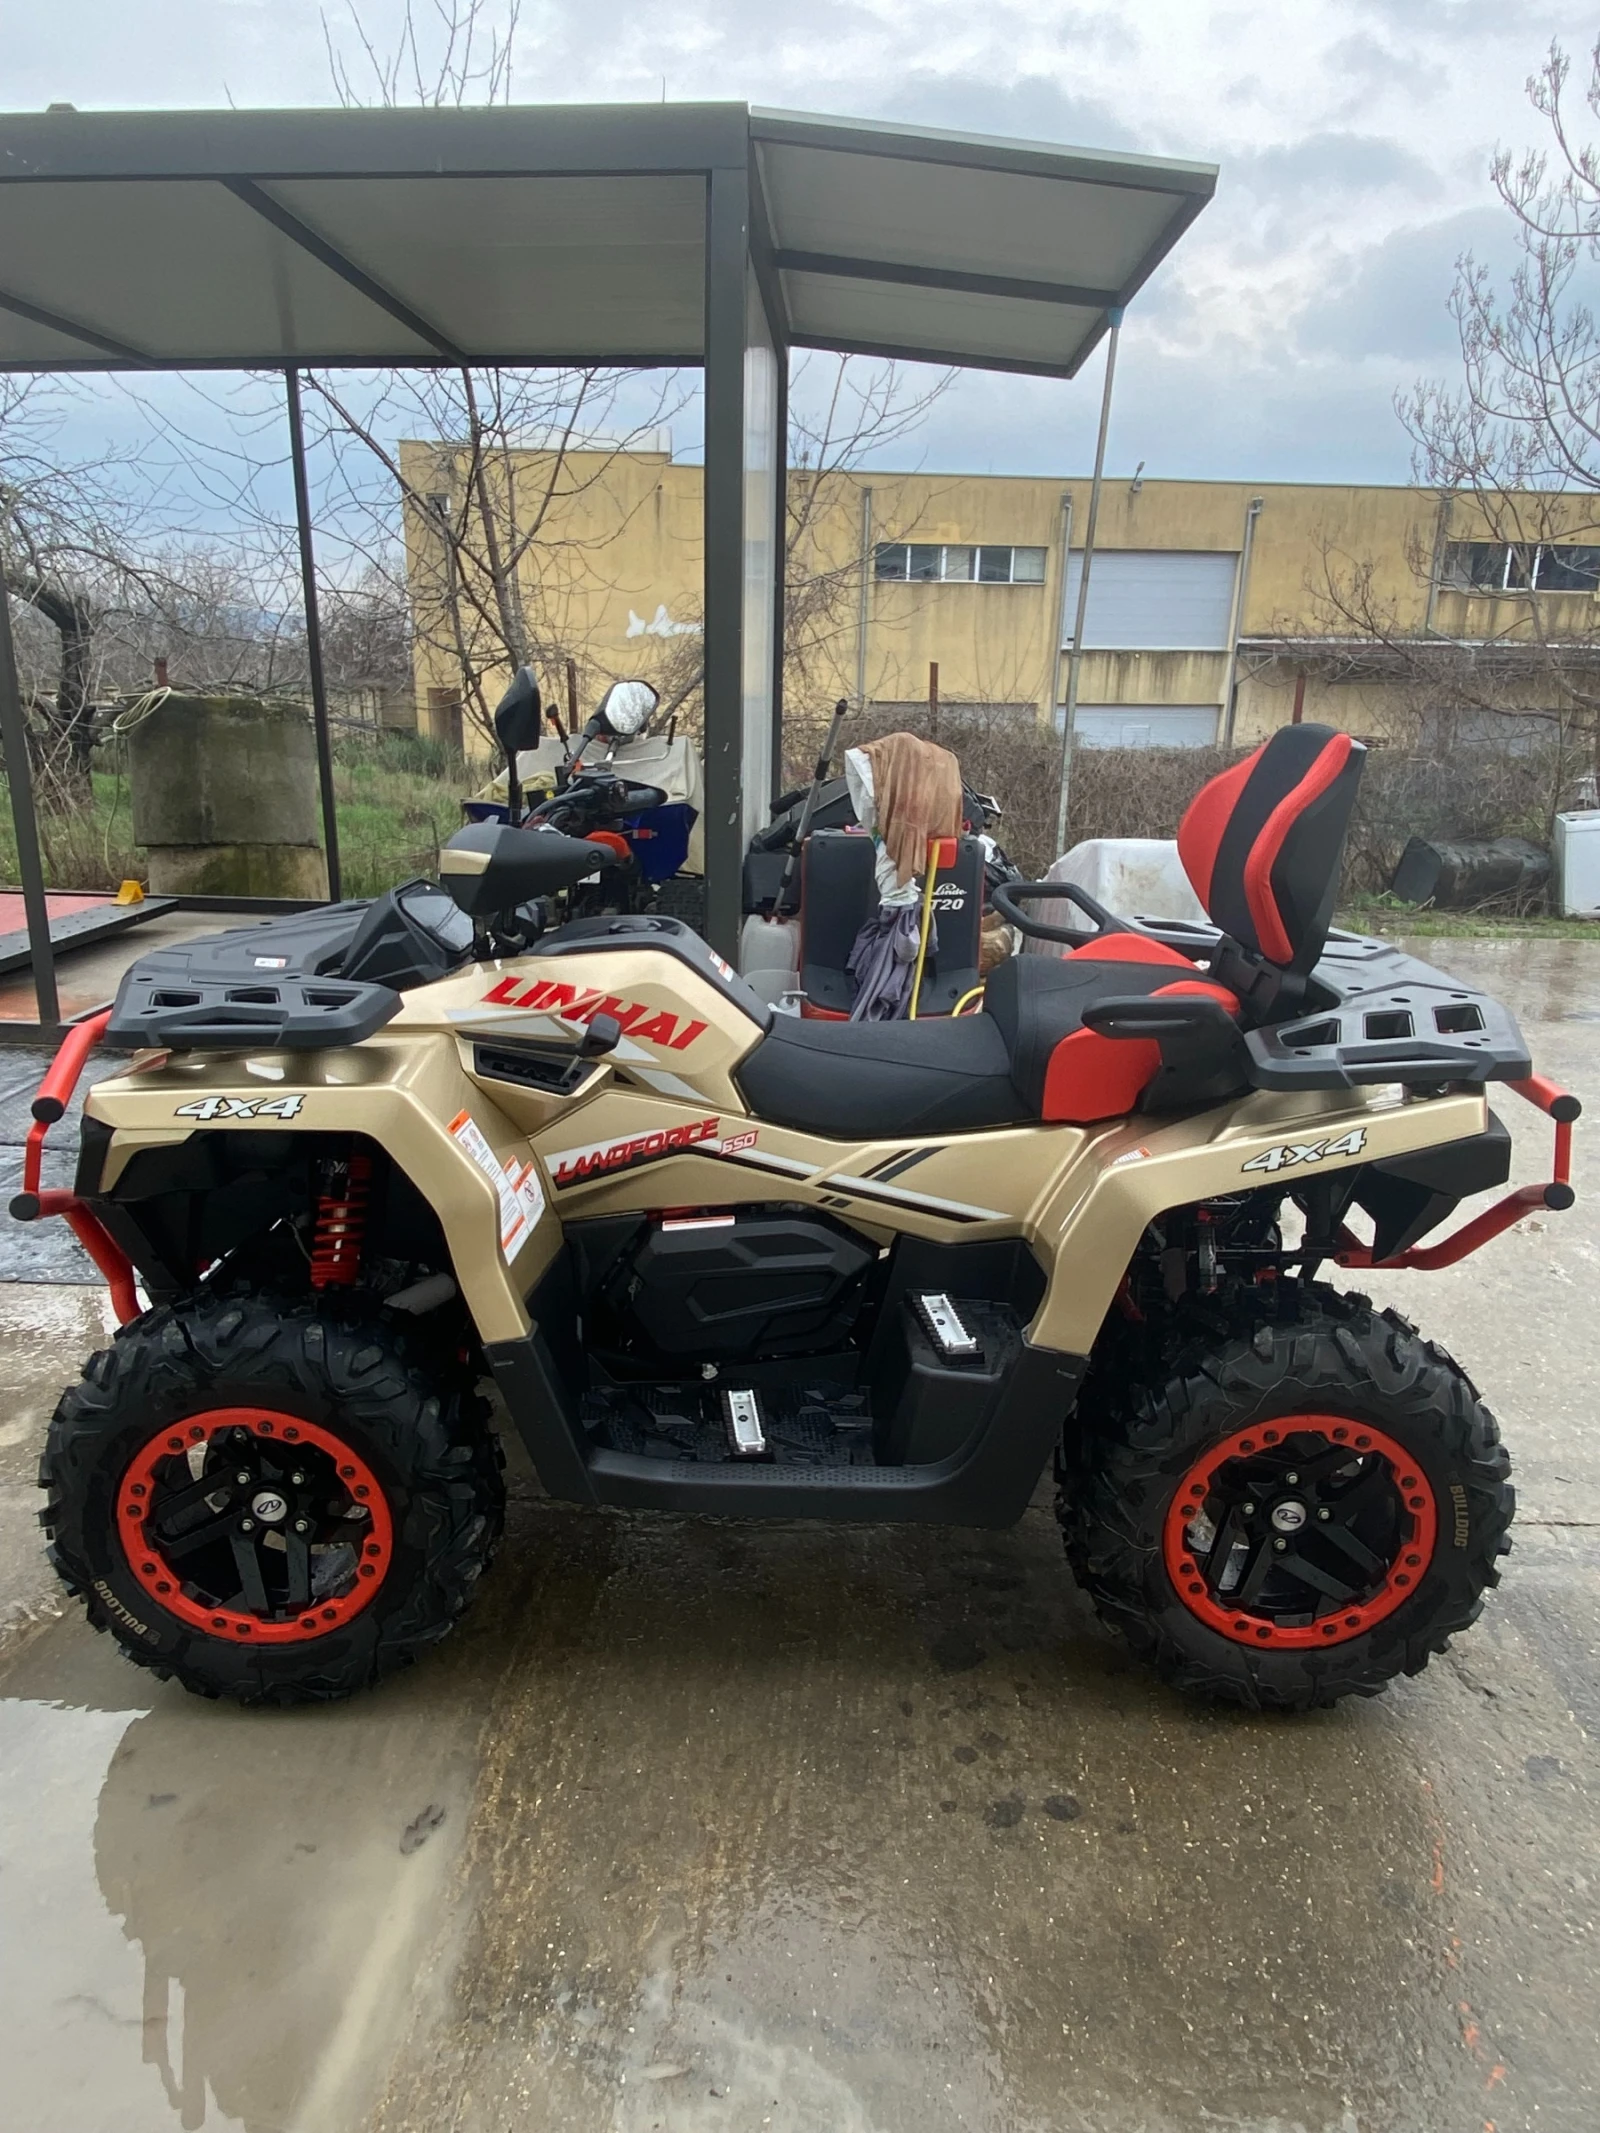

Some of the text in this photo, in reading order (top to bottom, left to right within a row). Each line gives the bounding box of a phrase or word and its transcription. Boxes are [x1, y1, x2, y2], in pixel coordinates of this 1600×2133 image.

[930, 898, 965, 911] T20
[933, 882, 967, 896] Linde
[480, 976, 708, 1050] LINHAI
[555, 1117, 720, 1182] LANDFORCE
[719, 1130, 759, 1156] 650
[1450, 1485, 1469, 1547] BULLDOG
[94, 1580, 148, 1635] BULLDOG
